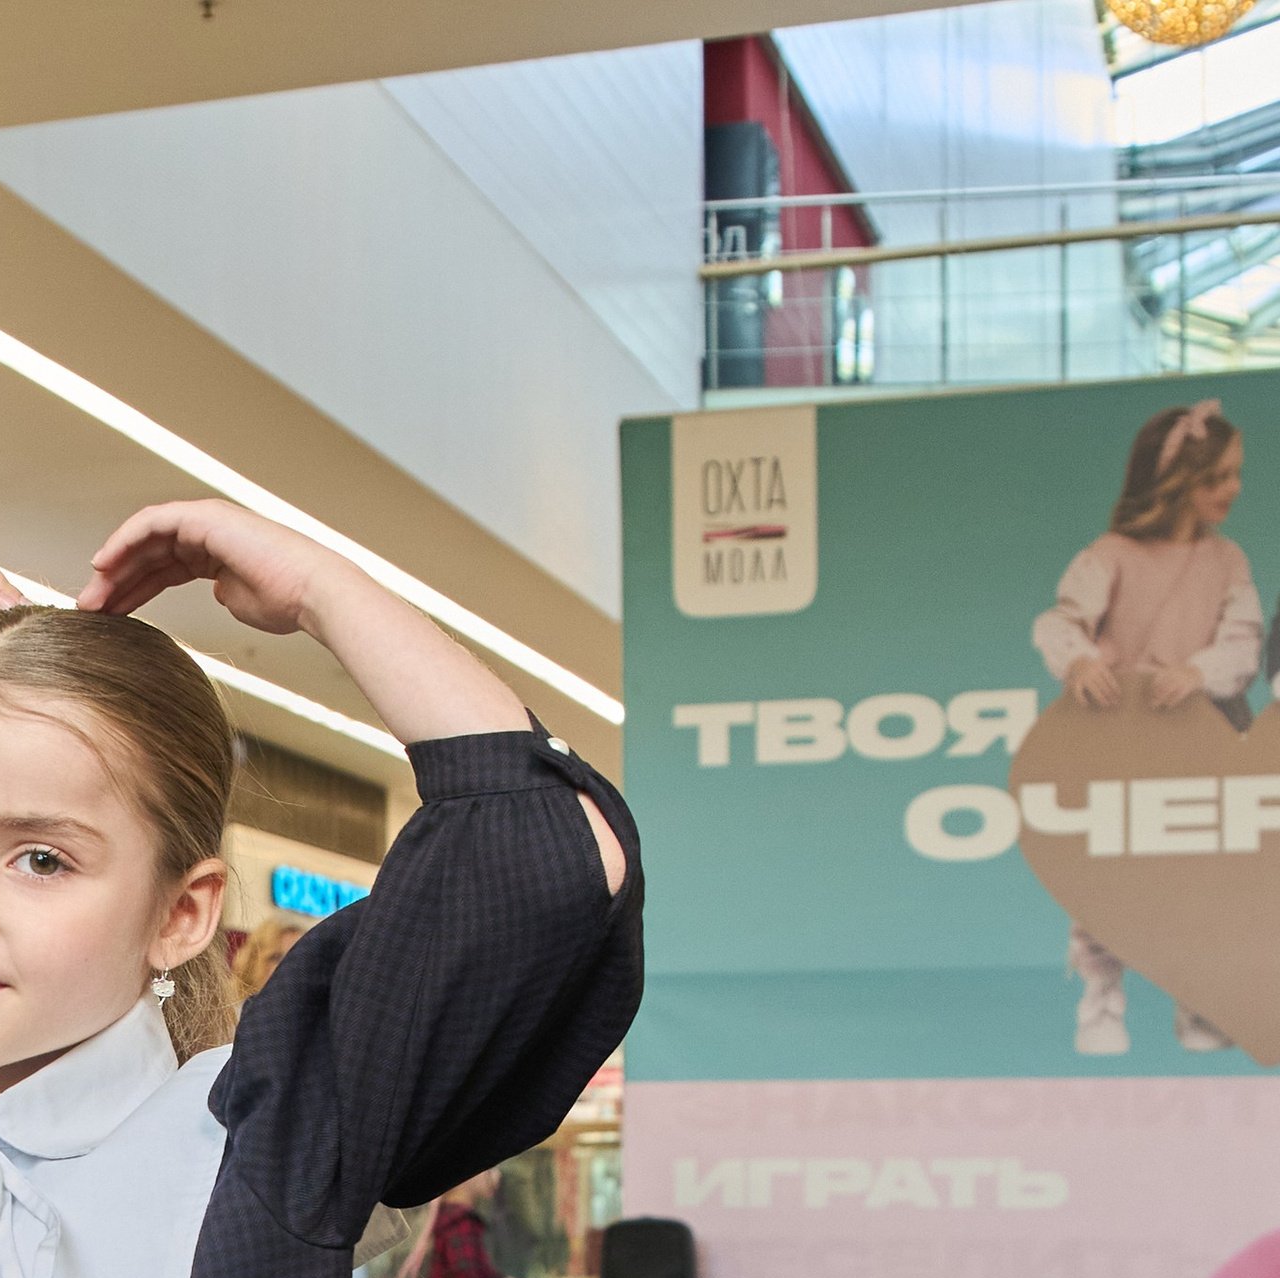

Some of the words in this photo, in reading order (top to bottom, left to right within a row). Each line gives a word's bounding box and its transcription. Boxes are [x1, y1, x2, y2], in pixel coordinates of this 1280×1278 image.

[701, 456, 788, 516] ОХТА
[703, 547, 789, 585] МОЛЛ
[672, 688, 1039, 768] ТВОЯ
[904, 774, 1280, 863] ОЧЕР
[671, 1157, 1070, 1211] ИГРАТЬ
